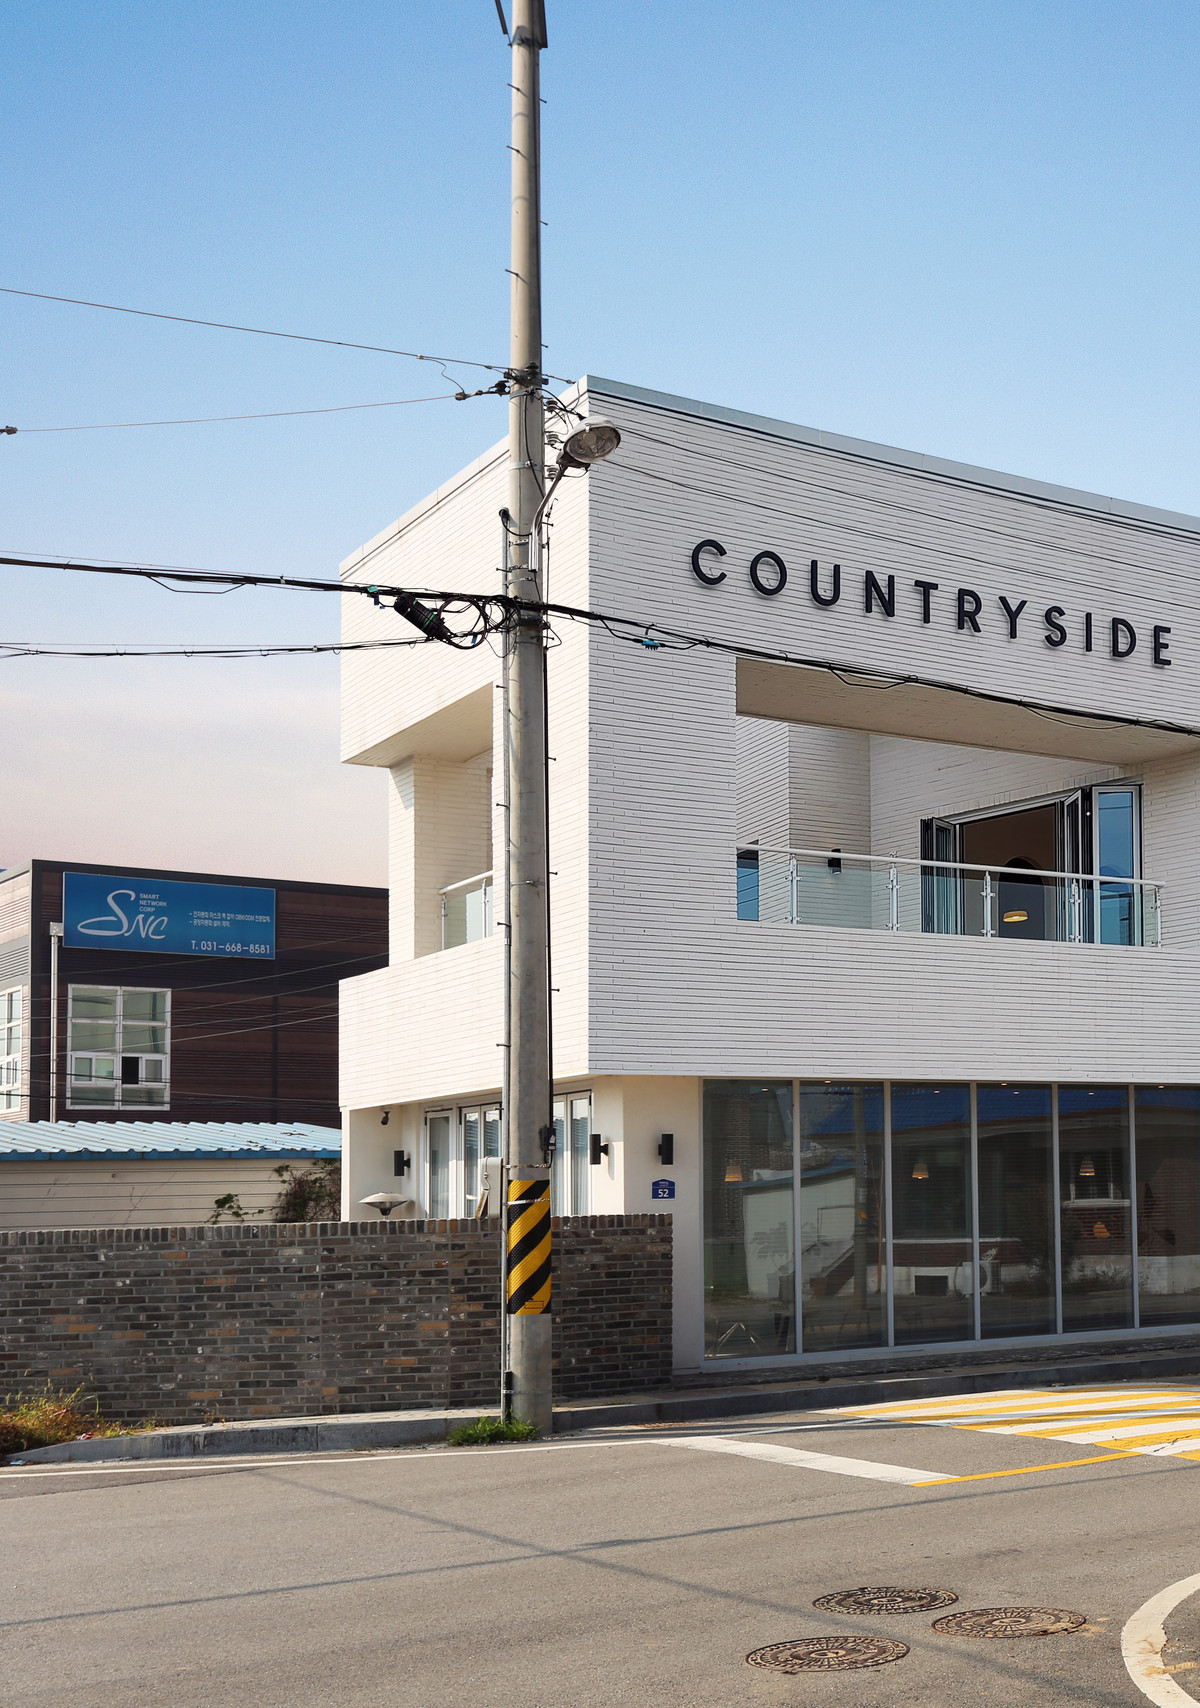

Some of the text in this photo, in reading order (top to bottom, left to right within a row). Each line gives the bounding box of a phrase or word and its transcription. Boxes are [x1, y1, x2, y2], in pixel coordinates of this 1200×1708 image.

[691, 538, 1172, 667] COUNTRYSIDE
[77, 889, 169, 940] SNC
[191, 940, 270, 954] T. 031-668-8581
[658, 1189, 669, 1197] 52
